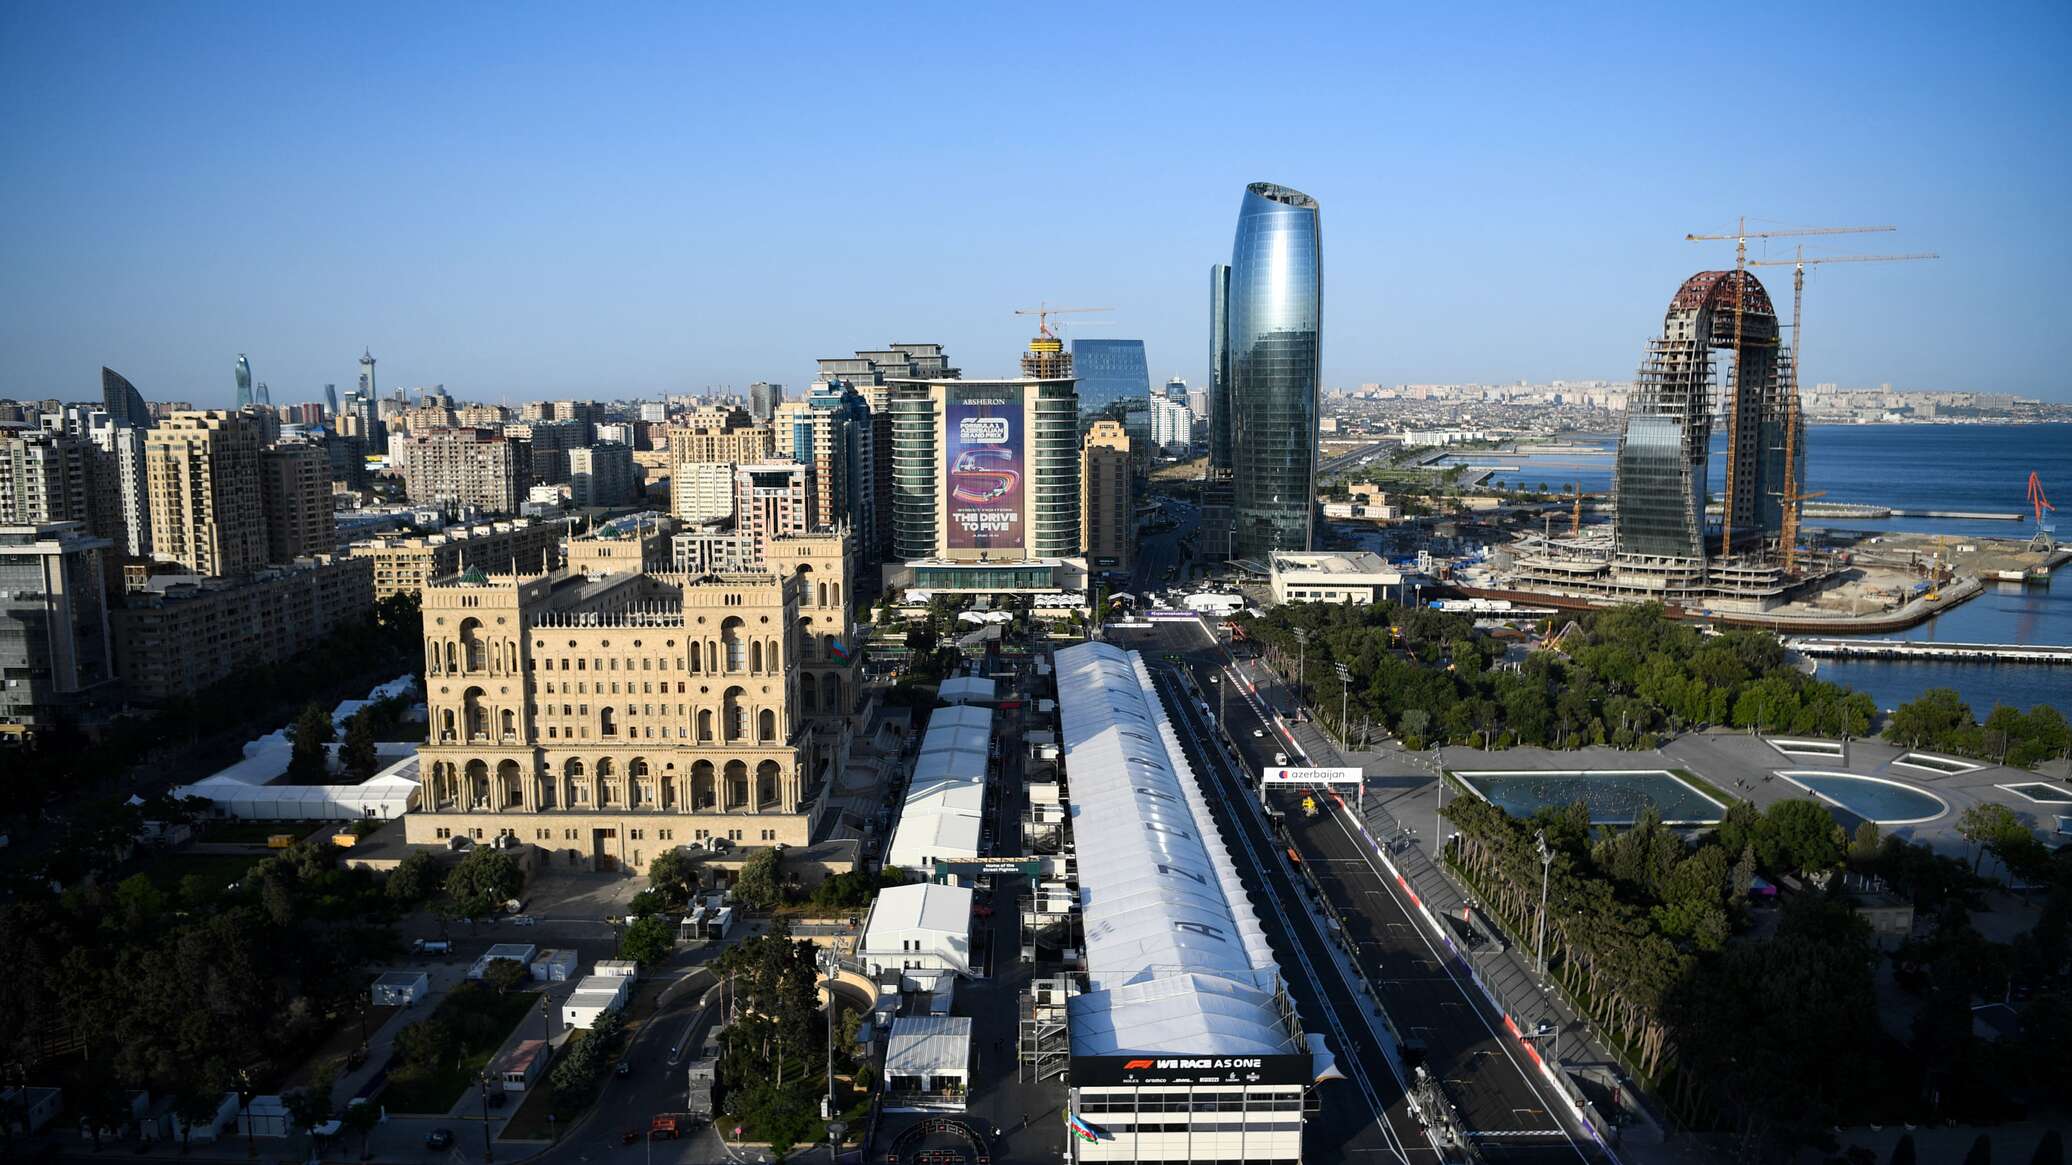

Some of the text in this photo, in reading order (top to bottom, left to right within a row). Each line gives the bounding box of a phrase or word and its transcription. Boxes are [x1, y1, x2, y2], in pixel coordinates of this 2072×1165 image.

[953, 513, 1018, 522] THE DRIVE
[961, 522, 1008, 531] TO FIVE
[1292, 770, 1344, 780] azerbaijan
[1157, 1059, 1262, 1069] WE RACE AS ONE
